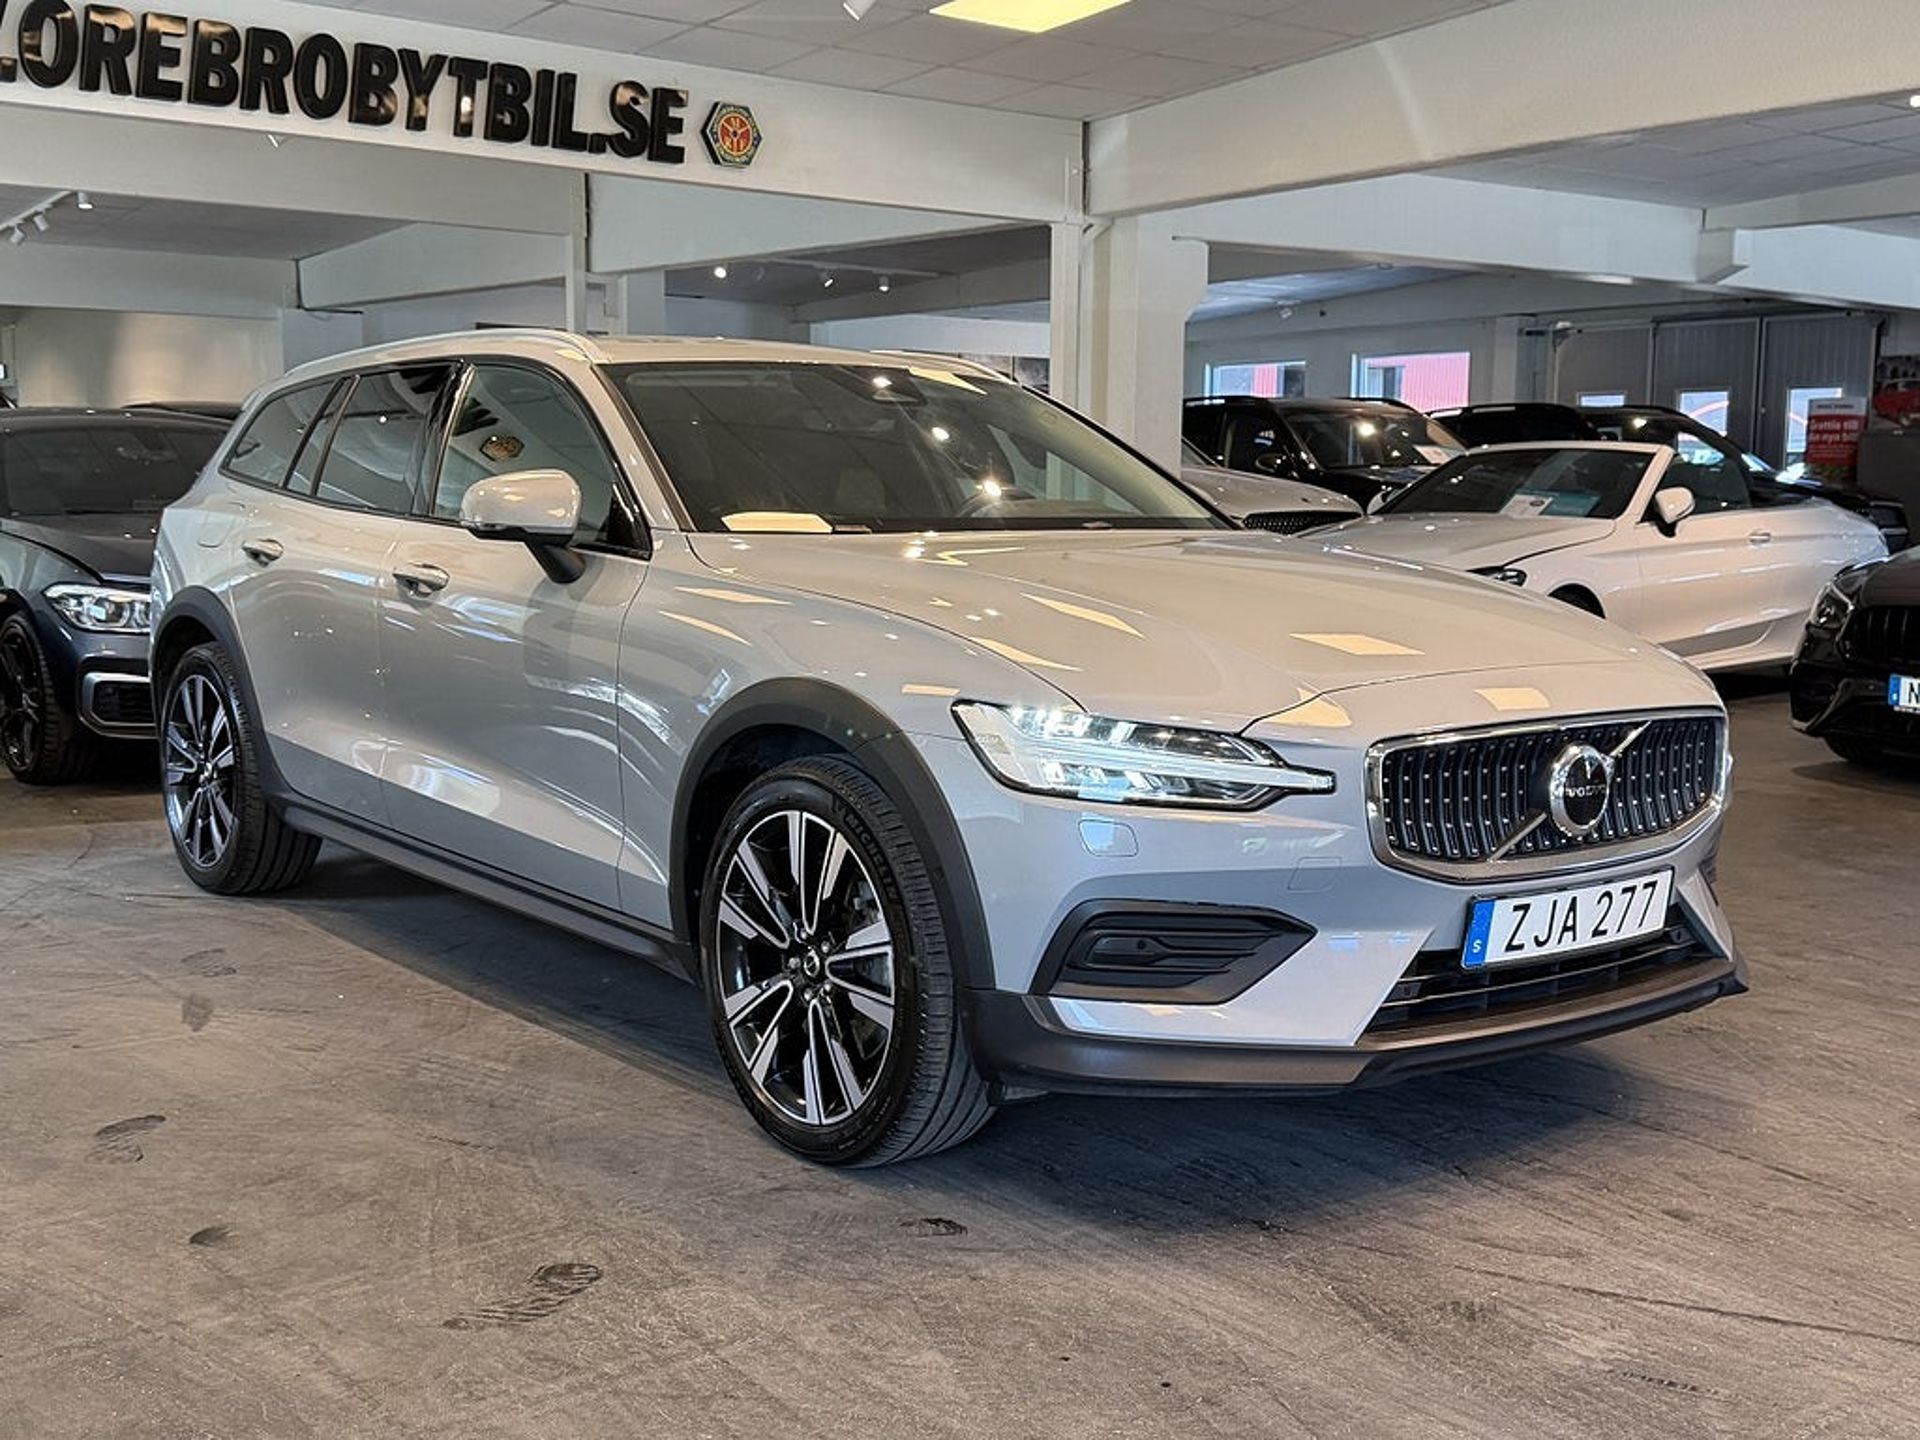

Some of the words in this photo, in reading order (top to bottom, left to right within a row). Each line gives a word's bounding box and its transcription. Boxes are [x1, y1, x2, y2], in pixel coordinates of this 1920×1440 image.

[0, 0, 689, 164] .OREBROBYTBIL.SE
[1472, 939, 1482, 953] S
[1505, 896, 1578, 952] ZJA
[1591, 880, 1658, 938] 277
